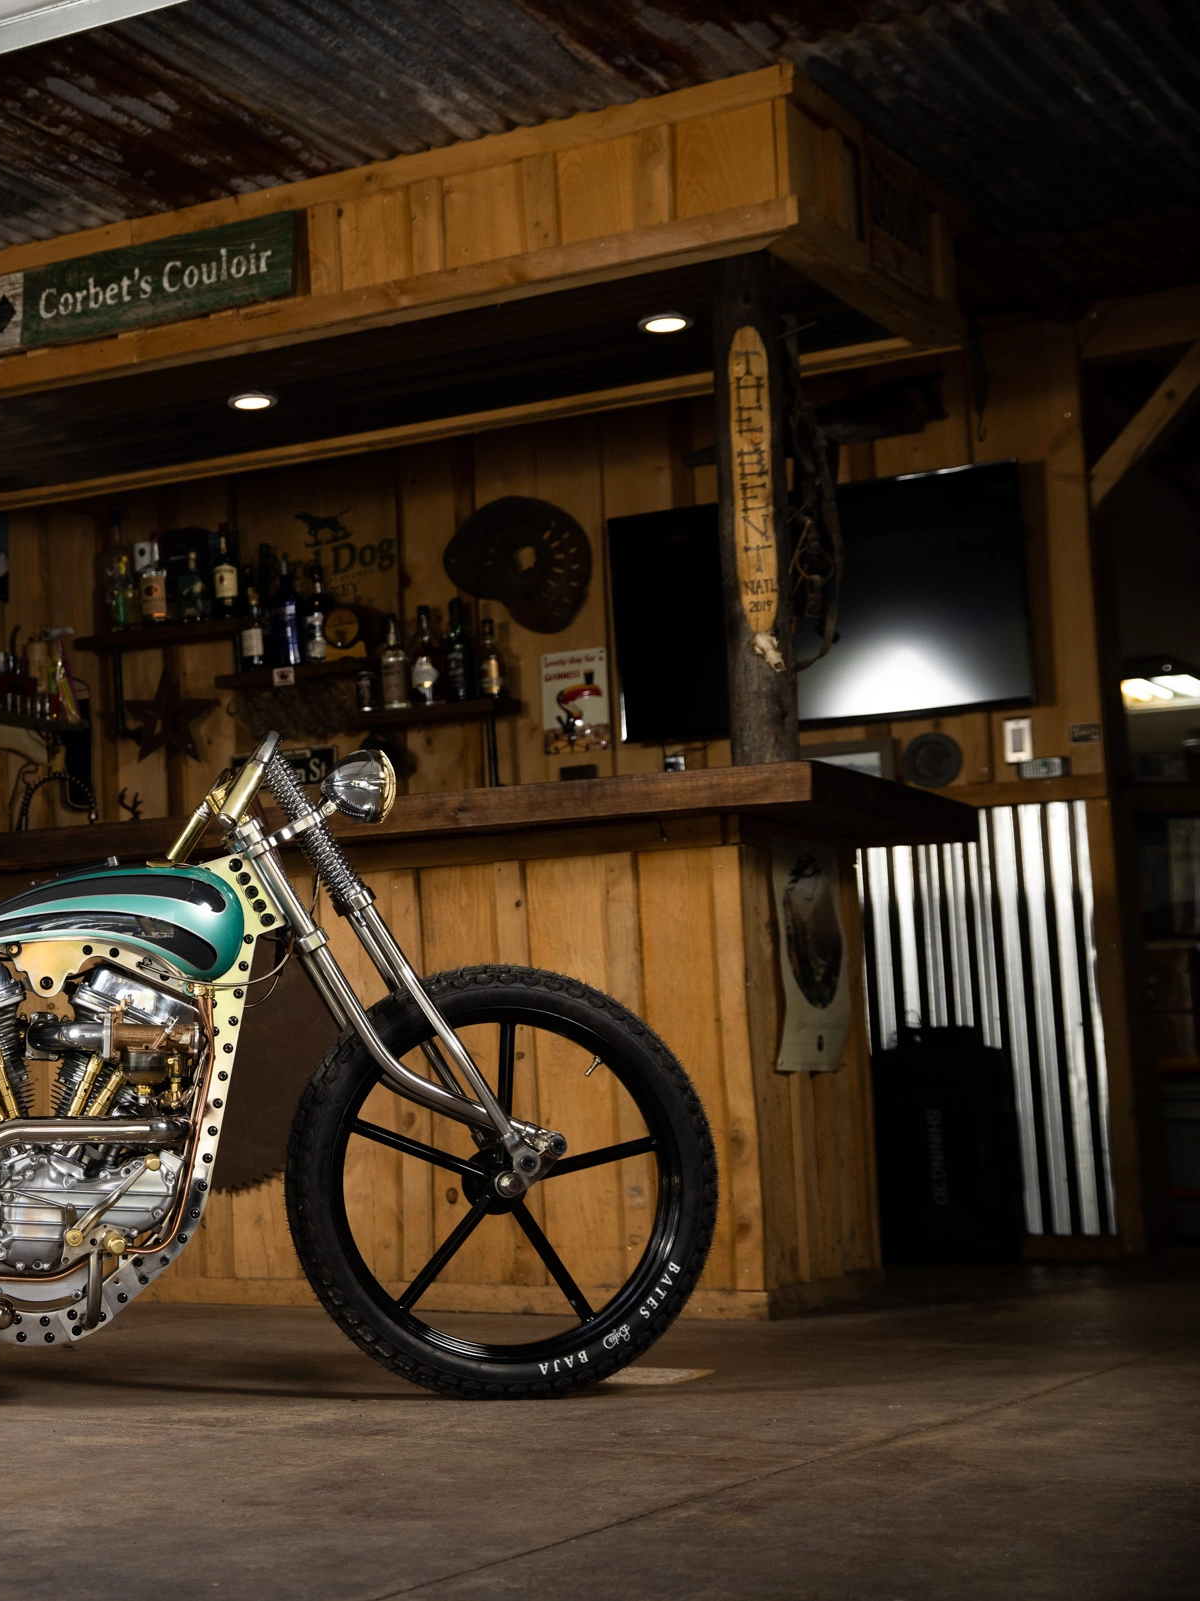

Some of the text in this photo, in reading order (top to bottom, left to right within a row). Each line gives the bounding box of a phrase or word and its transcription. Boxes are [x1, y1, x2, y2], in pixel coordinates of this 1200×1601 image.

[38, 242, 273, 320] Corbet's Couloir
[331, 538, 397, 575] Dog
[749, 600, 773, 613] 2019
[544, 657, 567, 668] Lovely
[569, 655, 583, 665] day
[585, 654, 596, 663] for
[544, 670, 581, 682] GUINNESS
[639, 1261, 681, 1320] BATES
[538, 1350, 590, 1376] BAJA
